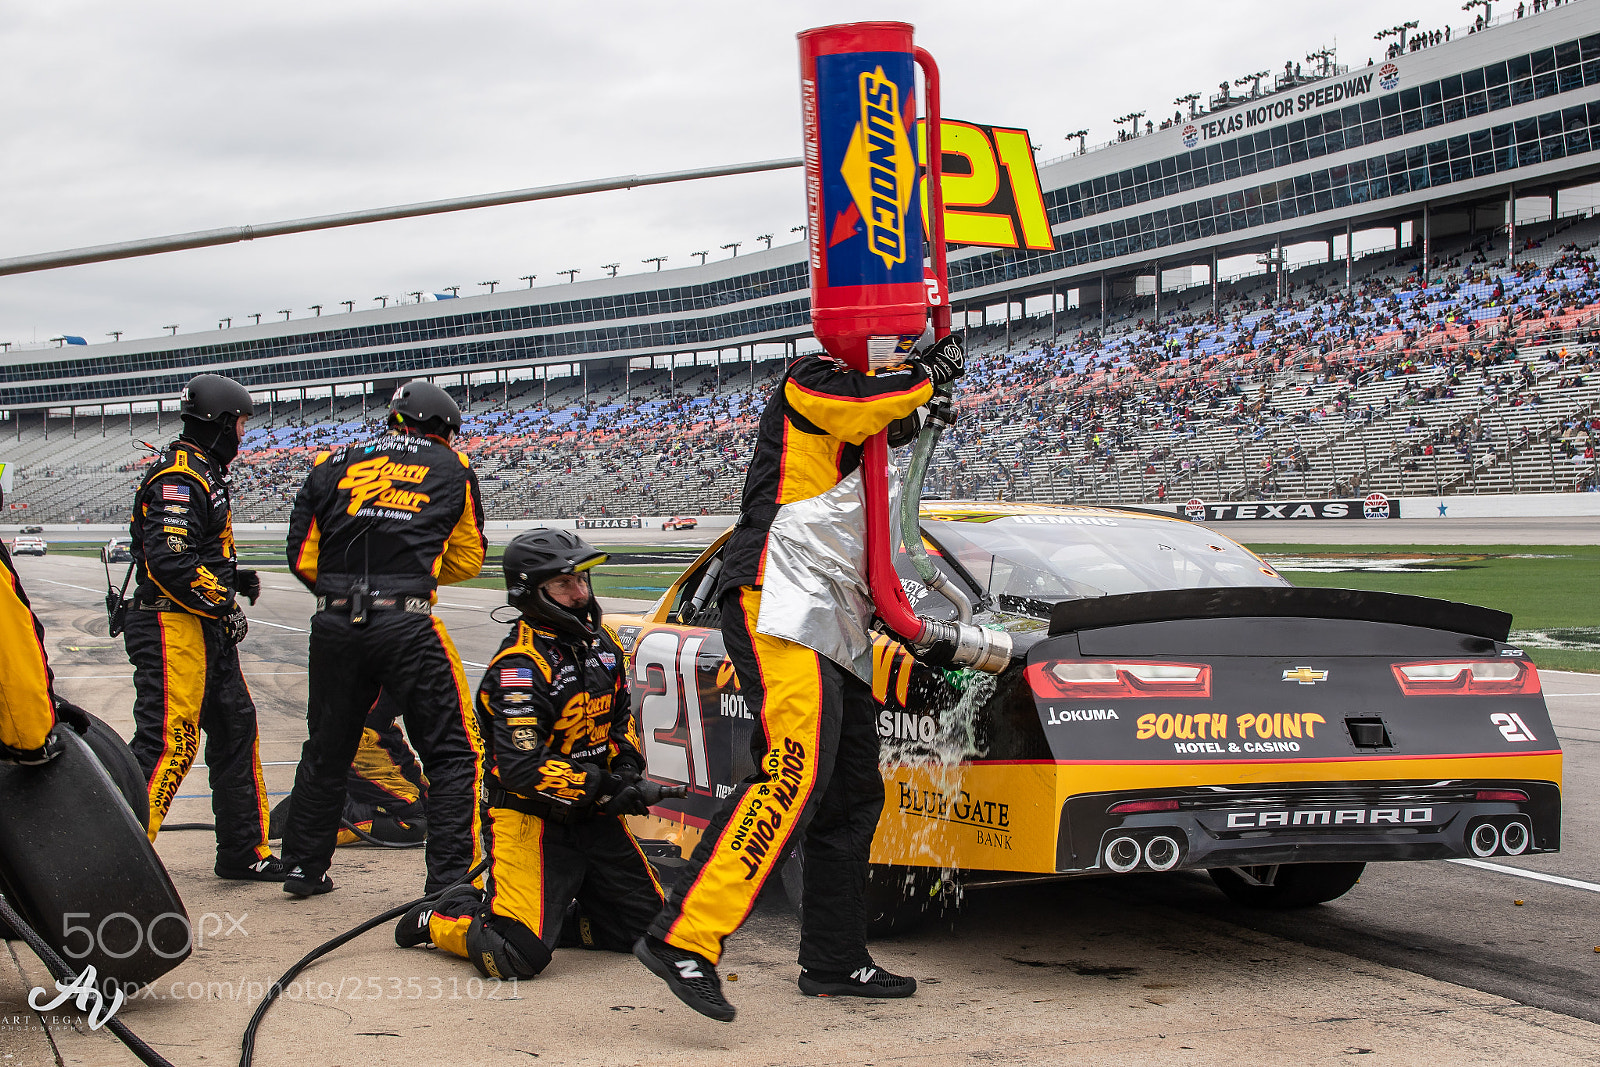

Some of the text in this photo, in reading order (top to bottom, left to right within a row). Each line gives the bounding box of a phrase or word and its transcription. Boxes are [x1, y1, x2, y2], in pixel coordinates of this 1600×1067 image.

[1201, 73, 1374, 141] TEXAS MOTOR SPEEDWAY
[866, 79, 901, 259] SUNOCO
[917, 122, 1053, 249] 21
[338, 456, 431, 489] SOUTH
[347, 479, 431, 516] POINT
[1210, 503, 1349, 519] TEXAS
[587, 519, 628, 528] TEXAS
[1011, 515, 1119, 527] HEMRIC
[553, 691, 612, 730] SOUTH
[635, 632, 710, 789] 21
[1136, 713, 1326, 739] SOUTH POINT
[1490, 712, 1538, 742] 21
[179, 720, 197, 775] SOUTH
[1174, 741, 1300, 753] HOTEL & CASINO
[154, 728, 183, 808] HOTEL & CASINO
[740, 736, 806, 881] SOUTH POINT
[758, 784, 770, 796] &
[899, 782, 1010, 828] BLUE GATE
[730, 798, 763, 851] CASINO
[1227, 807, 1433, 828] CAMARO
[977, 830, 1012, 850] BANK
